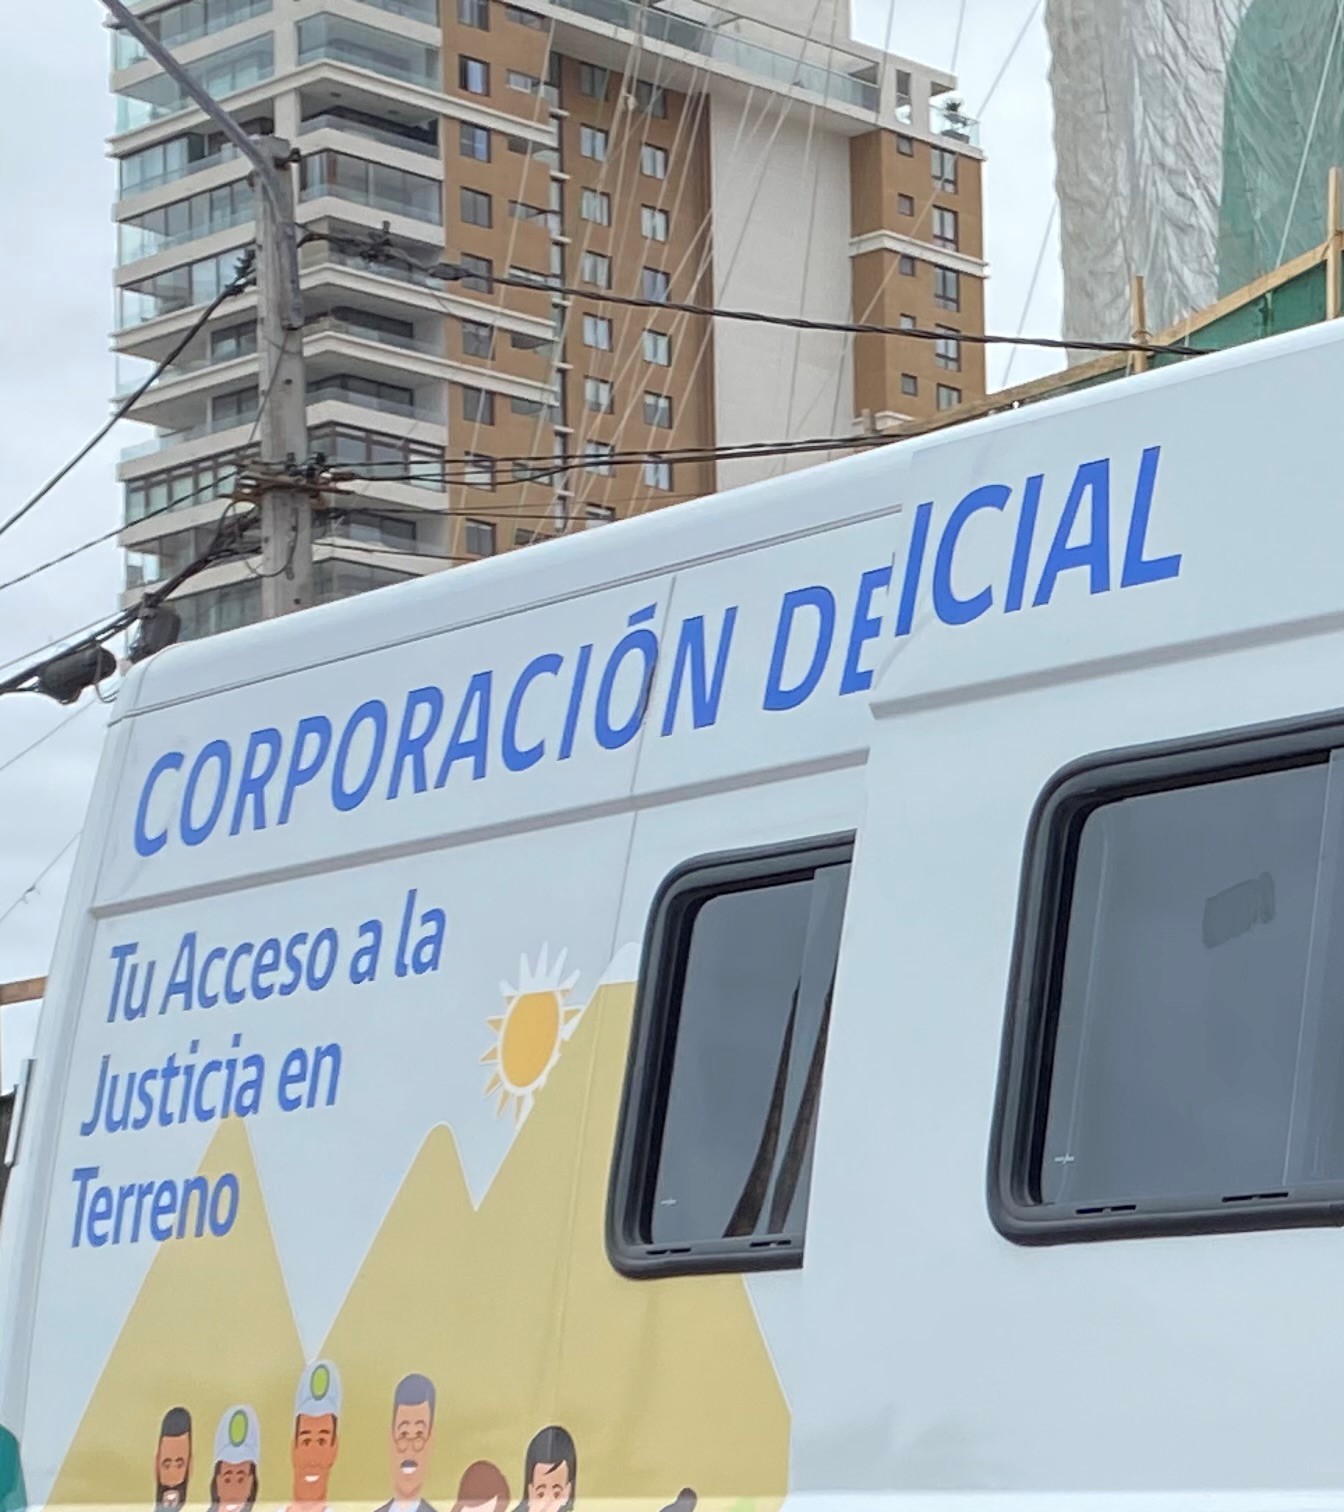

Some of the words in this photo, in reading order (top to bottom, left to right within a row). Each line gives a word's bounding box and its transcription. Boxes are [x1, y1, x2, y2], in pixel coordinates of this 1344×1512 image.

[134, 603, 738, 857] CORPORACIÓN
[763, 564, 893, 712] DE
[108, 940, 156, 1023] Tu
[159, 926, 338, 1015] Acceso
[349, 918, 382, 986] a
[394, 889, 447, 978] la
[80, 1036, 265, 1138] Justicia
[278, 1043, 341, 1111] en
[71, 1166, 240, 1249] Terreno
